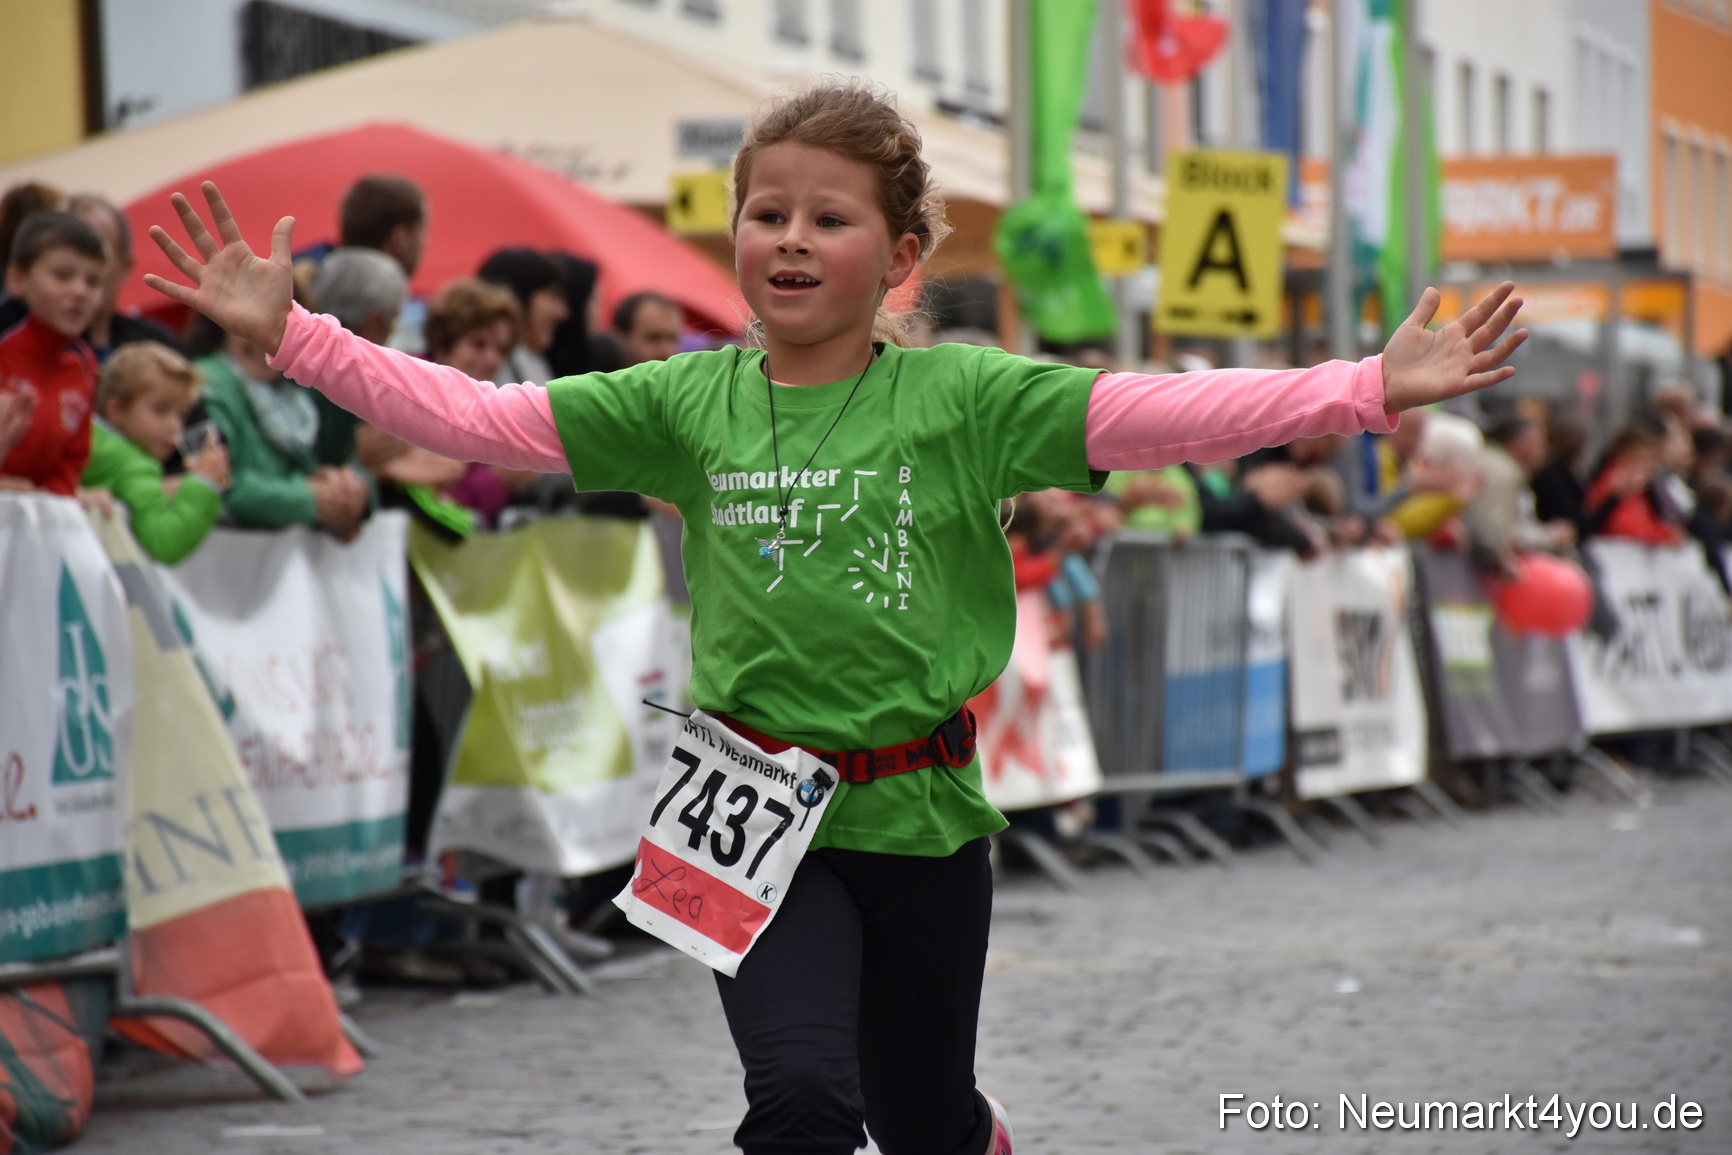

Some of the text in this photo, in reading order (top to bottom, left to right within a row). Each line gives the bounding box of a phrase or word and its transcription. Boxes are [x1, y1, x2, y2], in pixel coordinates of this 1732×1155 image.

[1181, 156, 1272, 193] Block
[1186, 208, 1249, 291] A
[895, 466, 913, 611] BAMBINI
[649, 745, 796, 881] 7437
[760, 883, 772, 901] K
